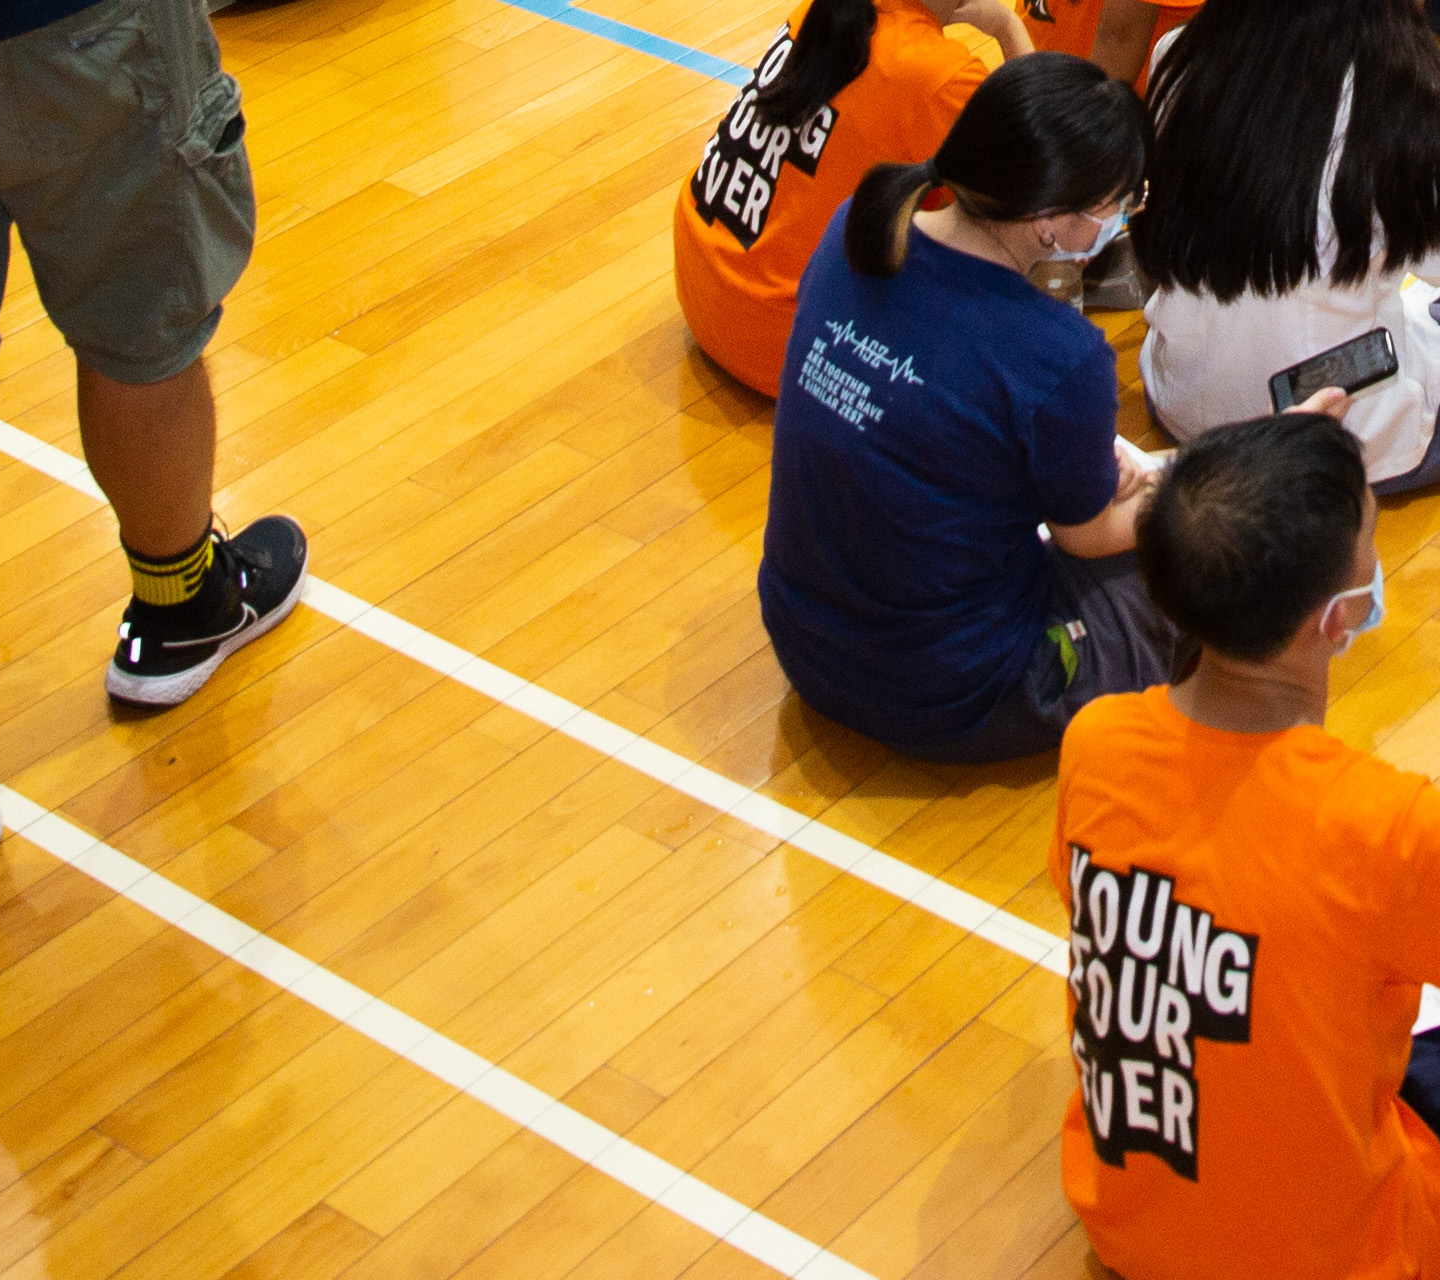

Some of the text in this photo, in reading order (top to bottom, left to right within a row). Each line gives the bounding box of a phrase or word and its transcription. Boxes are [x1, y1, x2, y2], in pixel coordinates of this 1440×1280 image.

[805, 351, 872, 399] ARE TOGETHER
[813, 337, 827, 356] WE
[801, 363, 885, 423] BECAUSE WE HAVE
[804, 378, 840, 412] SIMILAR
[1069, 845, 1249, 1016] YOUNG
[1069, 931, 1191, 1068] FOUR
[1071, 1035, 1193, 1154] EVER
